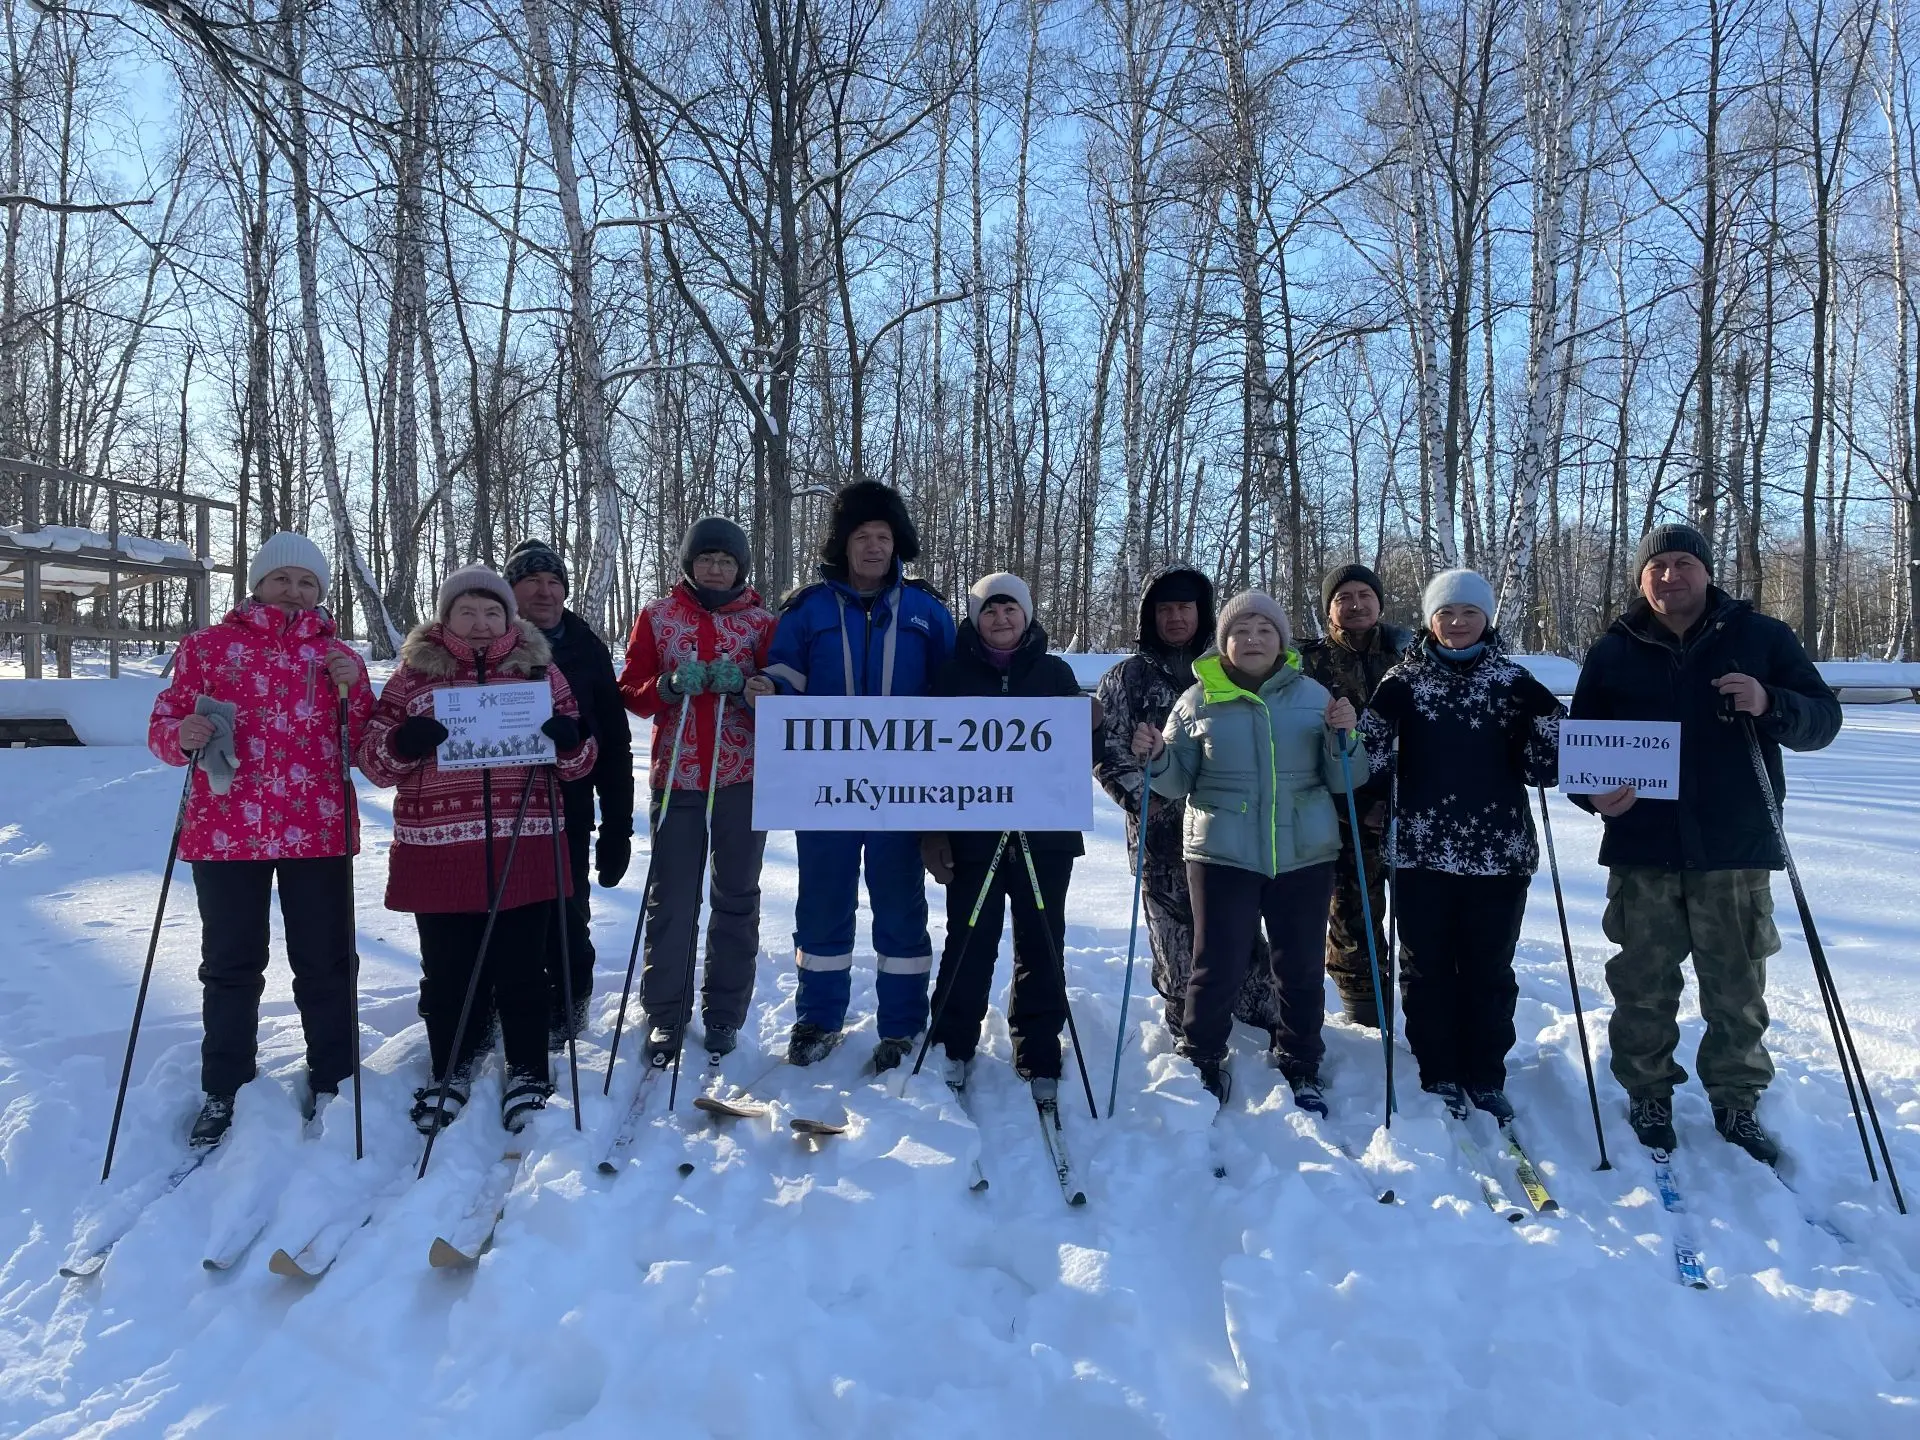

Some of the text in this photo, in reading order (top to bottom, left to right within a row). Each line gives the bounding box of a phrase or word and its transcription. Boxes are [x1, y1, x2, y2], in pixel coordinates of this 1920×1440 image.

[440, 716, 477, 725] ППМИ
[782, 718, 1052, 752] ППМИ-2026
[1566, 733, 1670, 749] ППМИ-2026
[1565, 772, 1668, 790] д.Кушкаран
[814, 778, 1014, 811] д.Кушкаран
